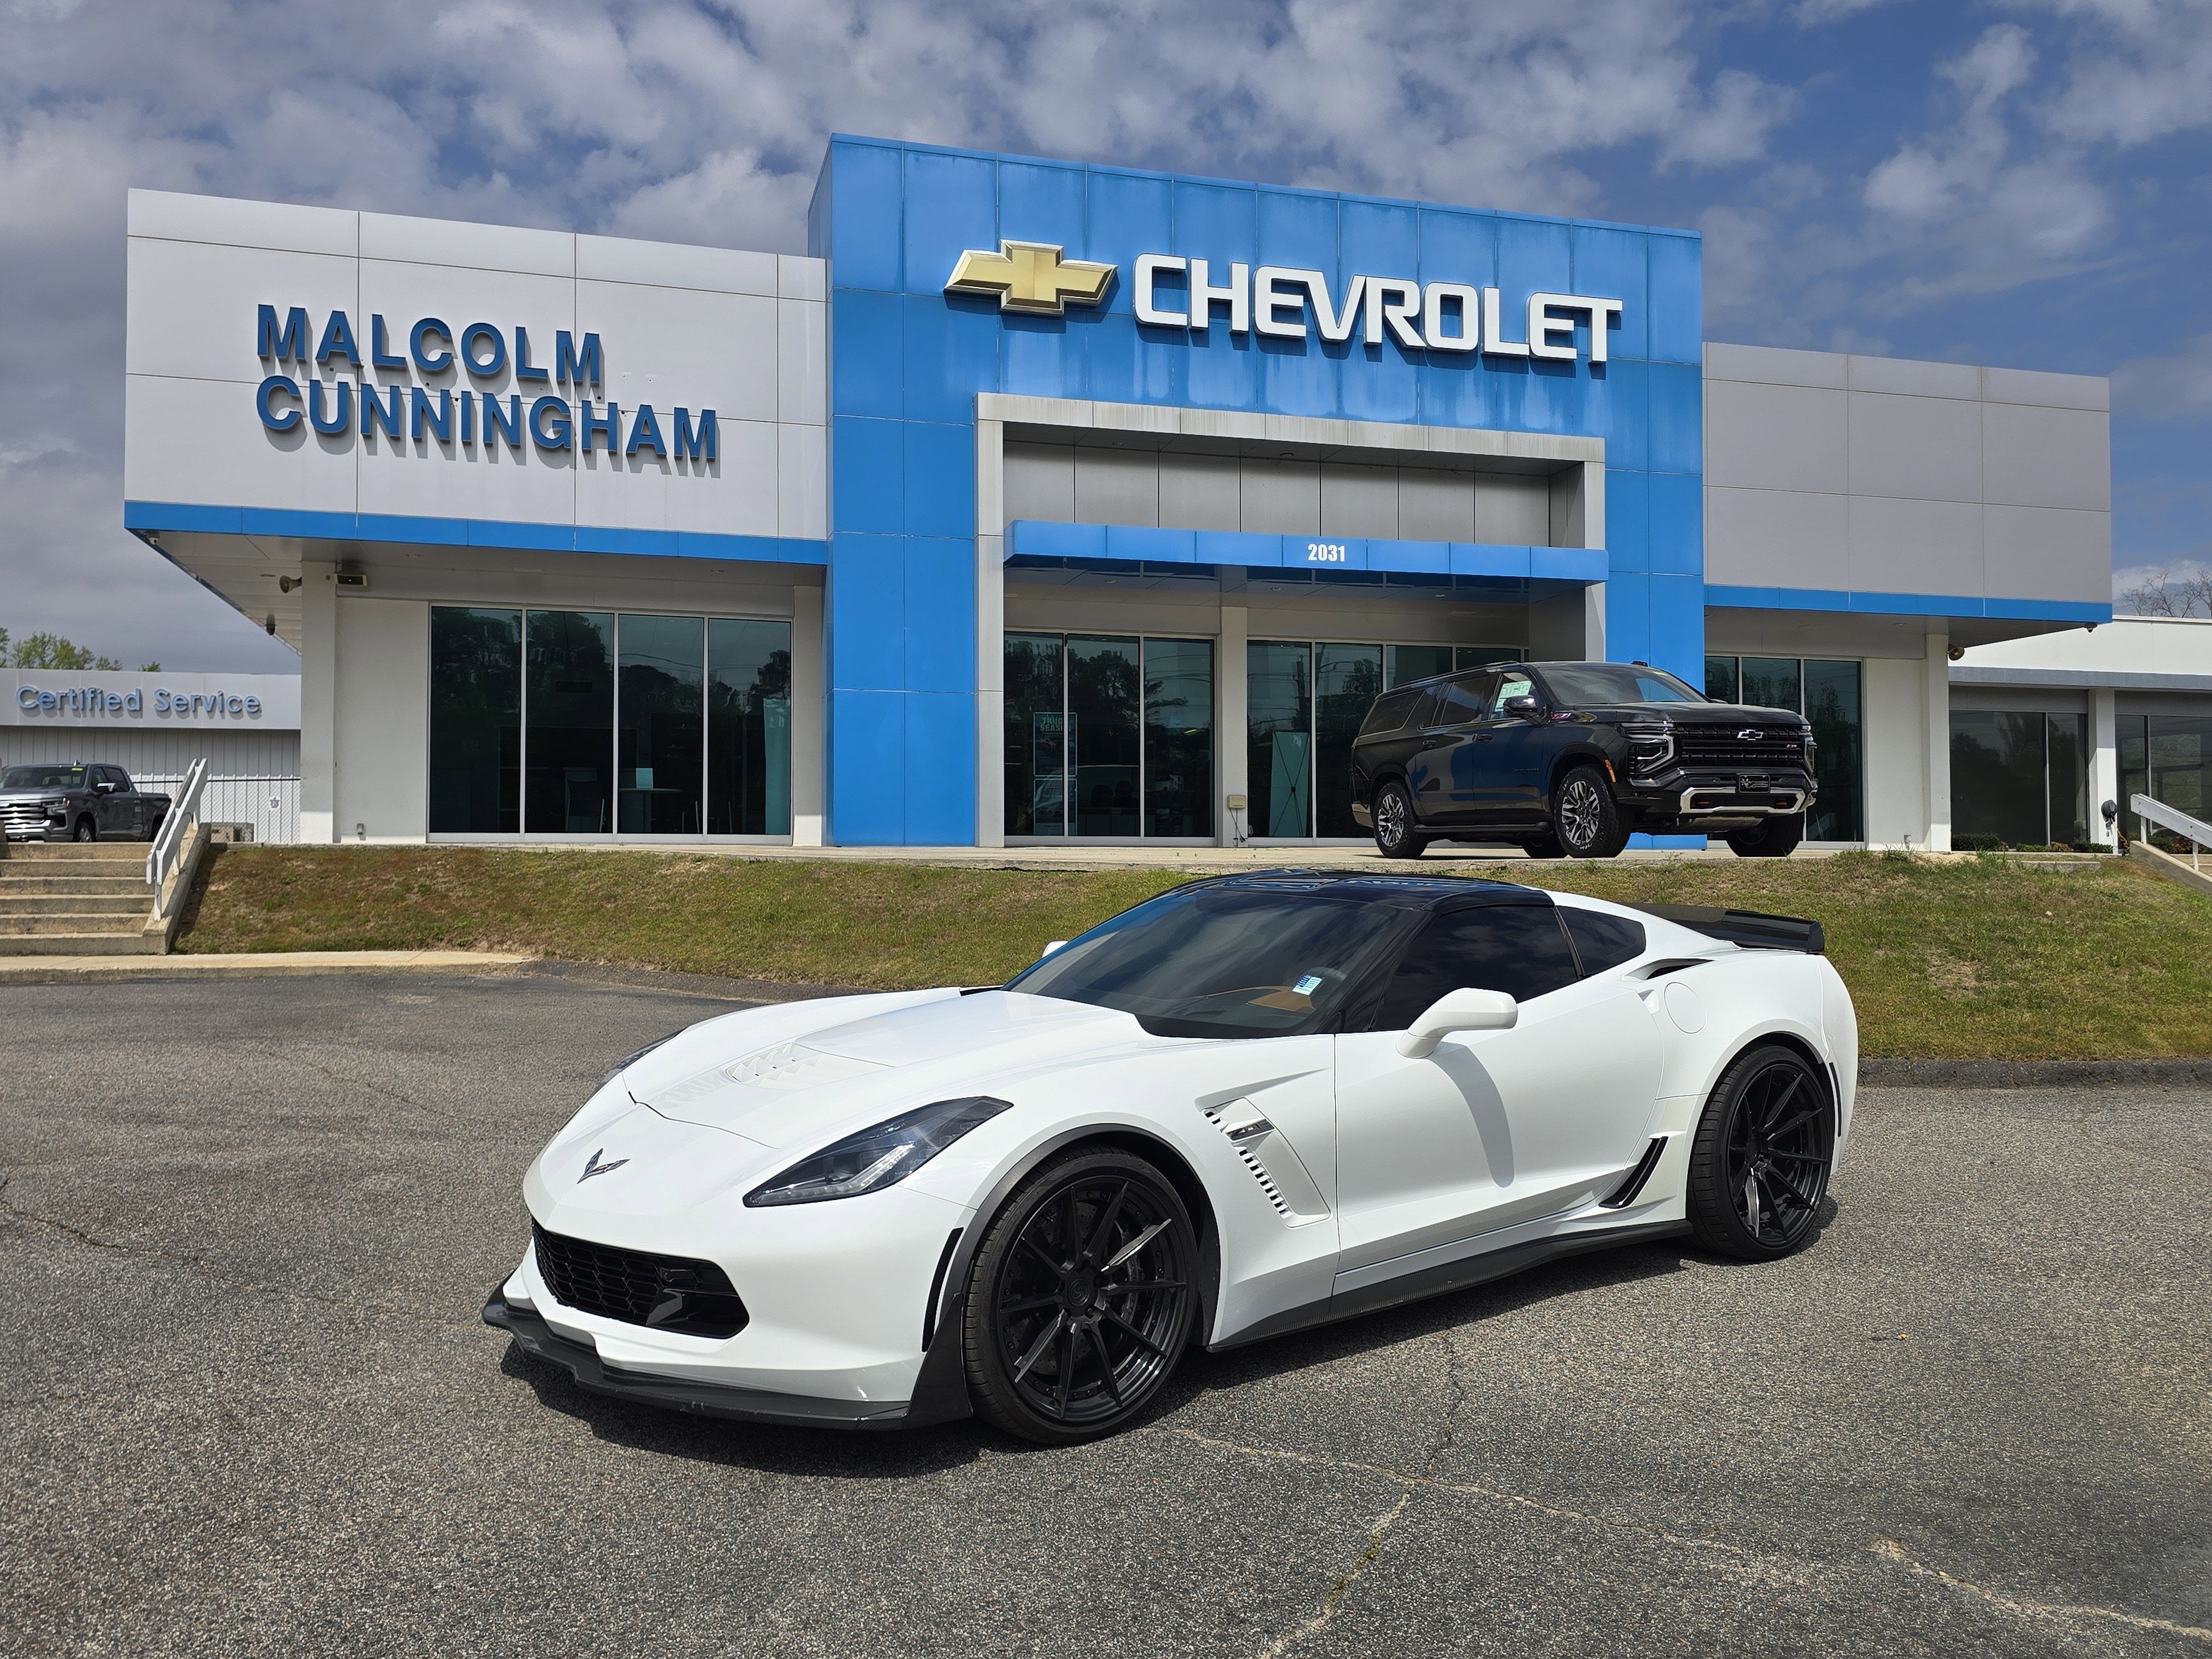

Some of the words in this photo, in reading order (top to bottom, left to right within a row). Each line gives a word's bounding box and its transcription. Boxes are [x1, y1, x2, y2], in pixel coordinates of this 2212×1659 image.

[1133, 253, 1623, 364] CHEVROLET
[257, 304, 600, 386] MALCOLM
[256, 375, 717, 460] CUNNINGHAM
[1308, 543, 1345, 562] 2031
[15, 685, 141, 711] Certified
[153, 688, 260, 713] Service
[1040, 723, 1072, 732] SEAS
